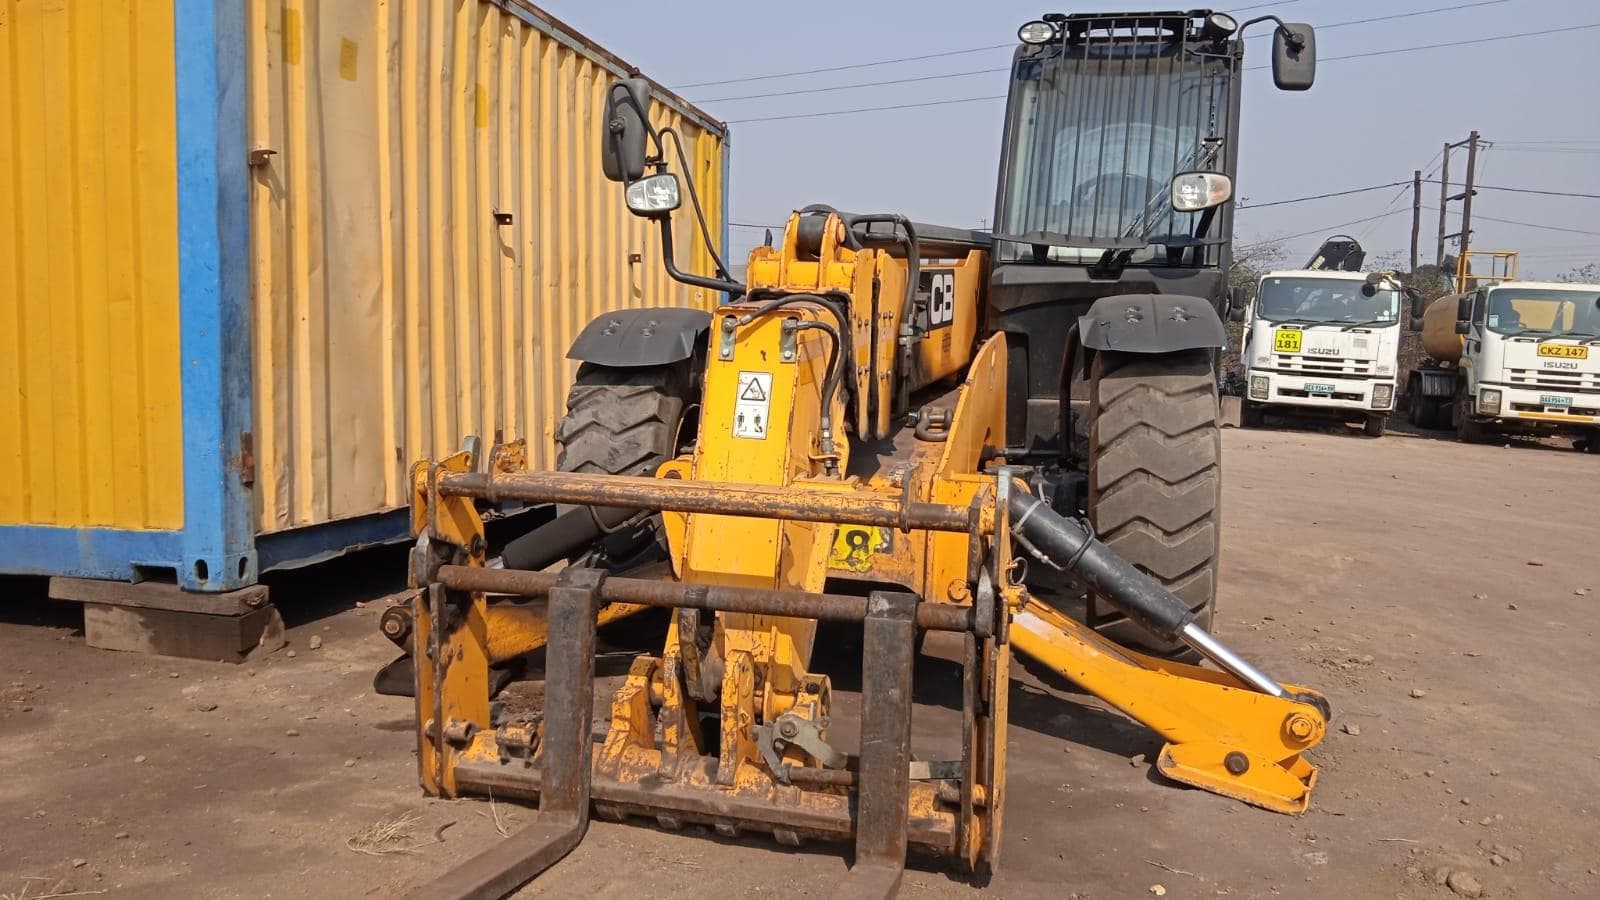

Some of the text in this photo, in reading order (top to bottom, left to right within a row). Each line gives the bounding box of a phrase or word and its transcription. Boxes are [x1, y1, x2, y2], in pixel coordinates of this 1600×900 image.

[930, 273, 954, 325] CB
[1276, 340, 1299, 349] 181
[1307, 347, 1340, 356] ISUZU
[1540, 346, 1585, 357] CKZ 147
[1543, 361, 1578, 370] ISUZU
